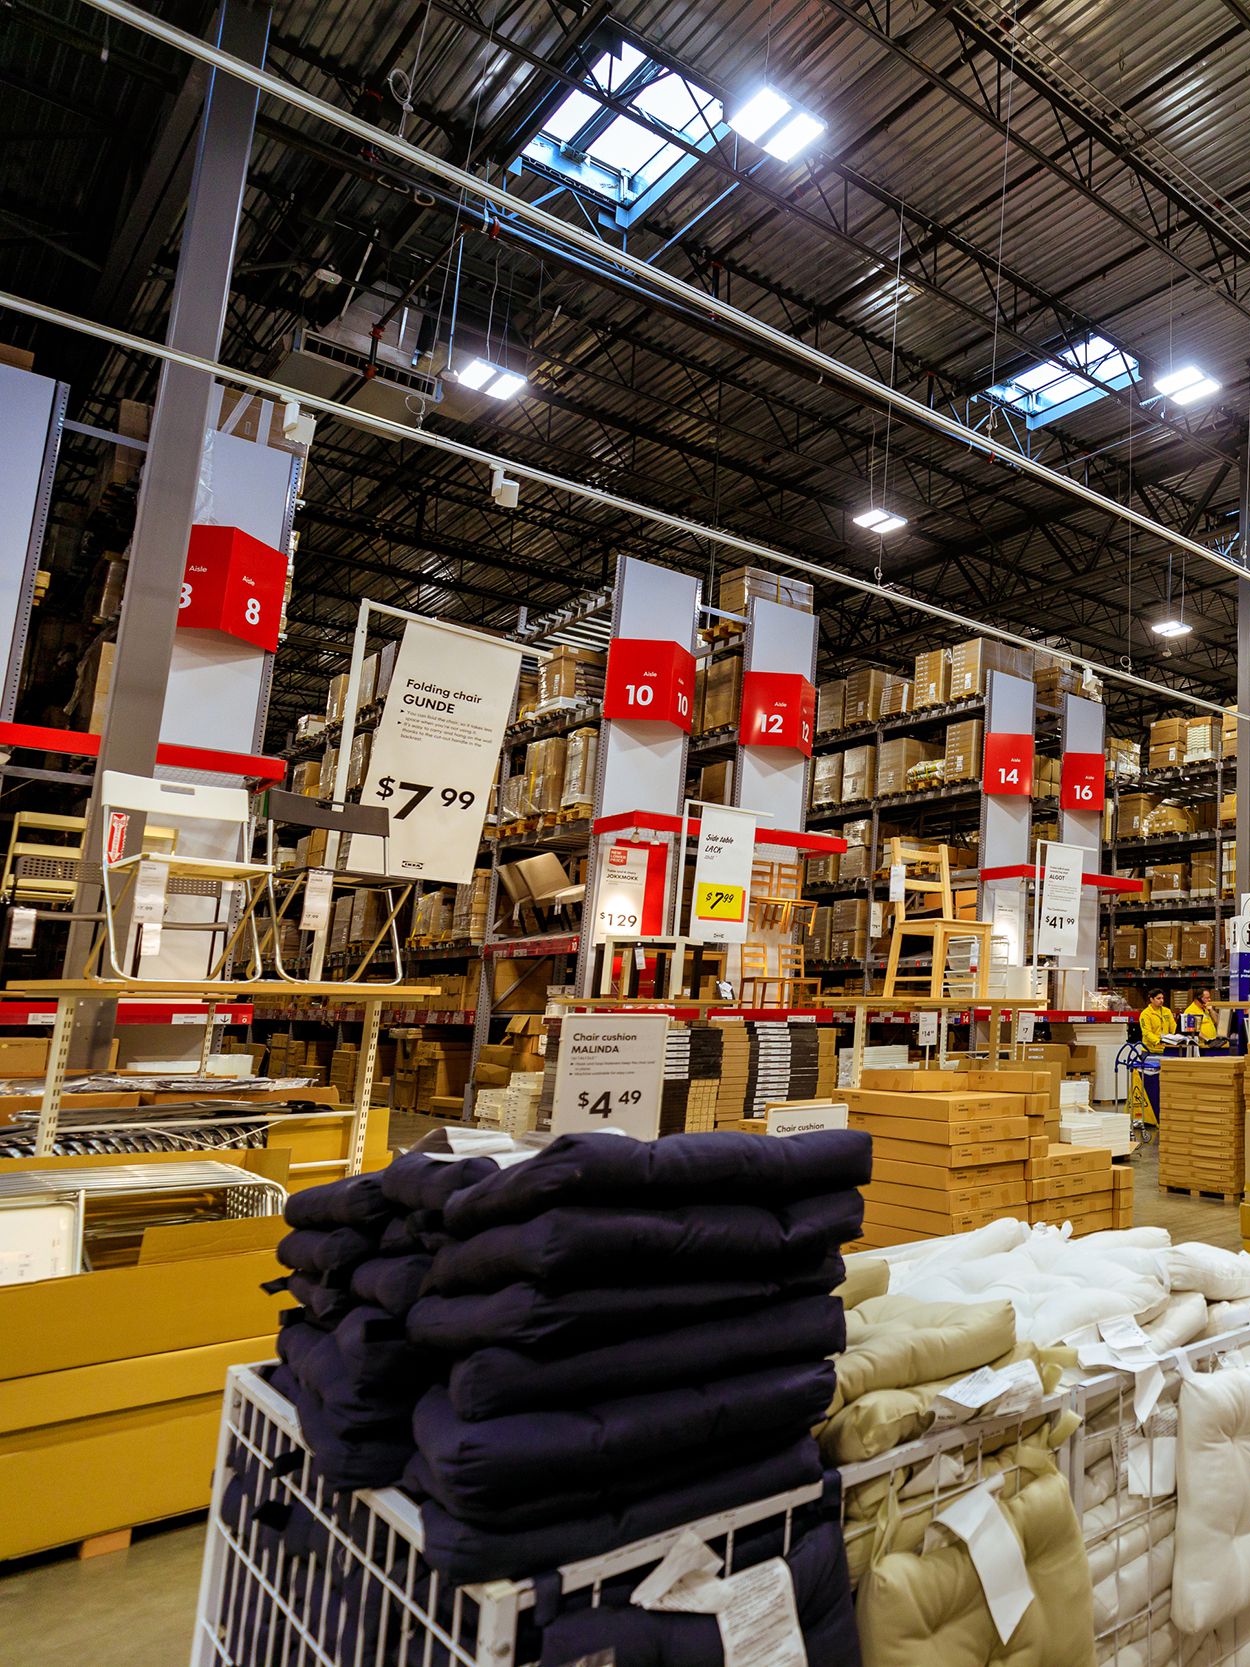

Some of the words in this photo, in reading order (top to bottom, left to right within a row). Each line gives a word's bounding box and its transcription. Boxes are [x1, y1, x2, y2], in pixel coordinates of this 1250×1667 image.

[242, 576, 256, 586] Aisle
[245, 598, 260, 625] 8
[406, 679, 450, 698] Folding
[453, 691, 482, 704] chair
[625, 685, 653, 706] 10
[403, 694, 456, 714] GUNDE
[677, 692, 688, 716] 10
[760, 714, 783, 734] 12
[802, 721, 809, 743] 12
[998, 768, 1019, 784] 14
[1074, 785, 1092, 800] 16
[706, 834, 719, 843] Side
[720, 836, 734, 844] table
[705, 846, 723, 854] LACK
[600, 912, 637, 927] $129
[572, 942, 577, 951] 10
[573, 1033, 599, 1041] Chair
[571, 1045, 619, 1053] MALINDA
[776, 1124, 796, 1133] Chair
[798, 1123, 824, 1131] cushion
